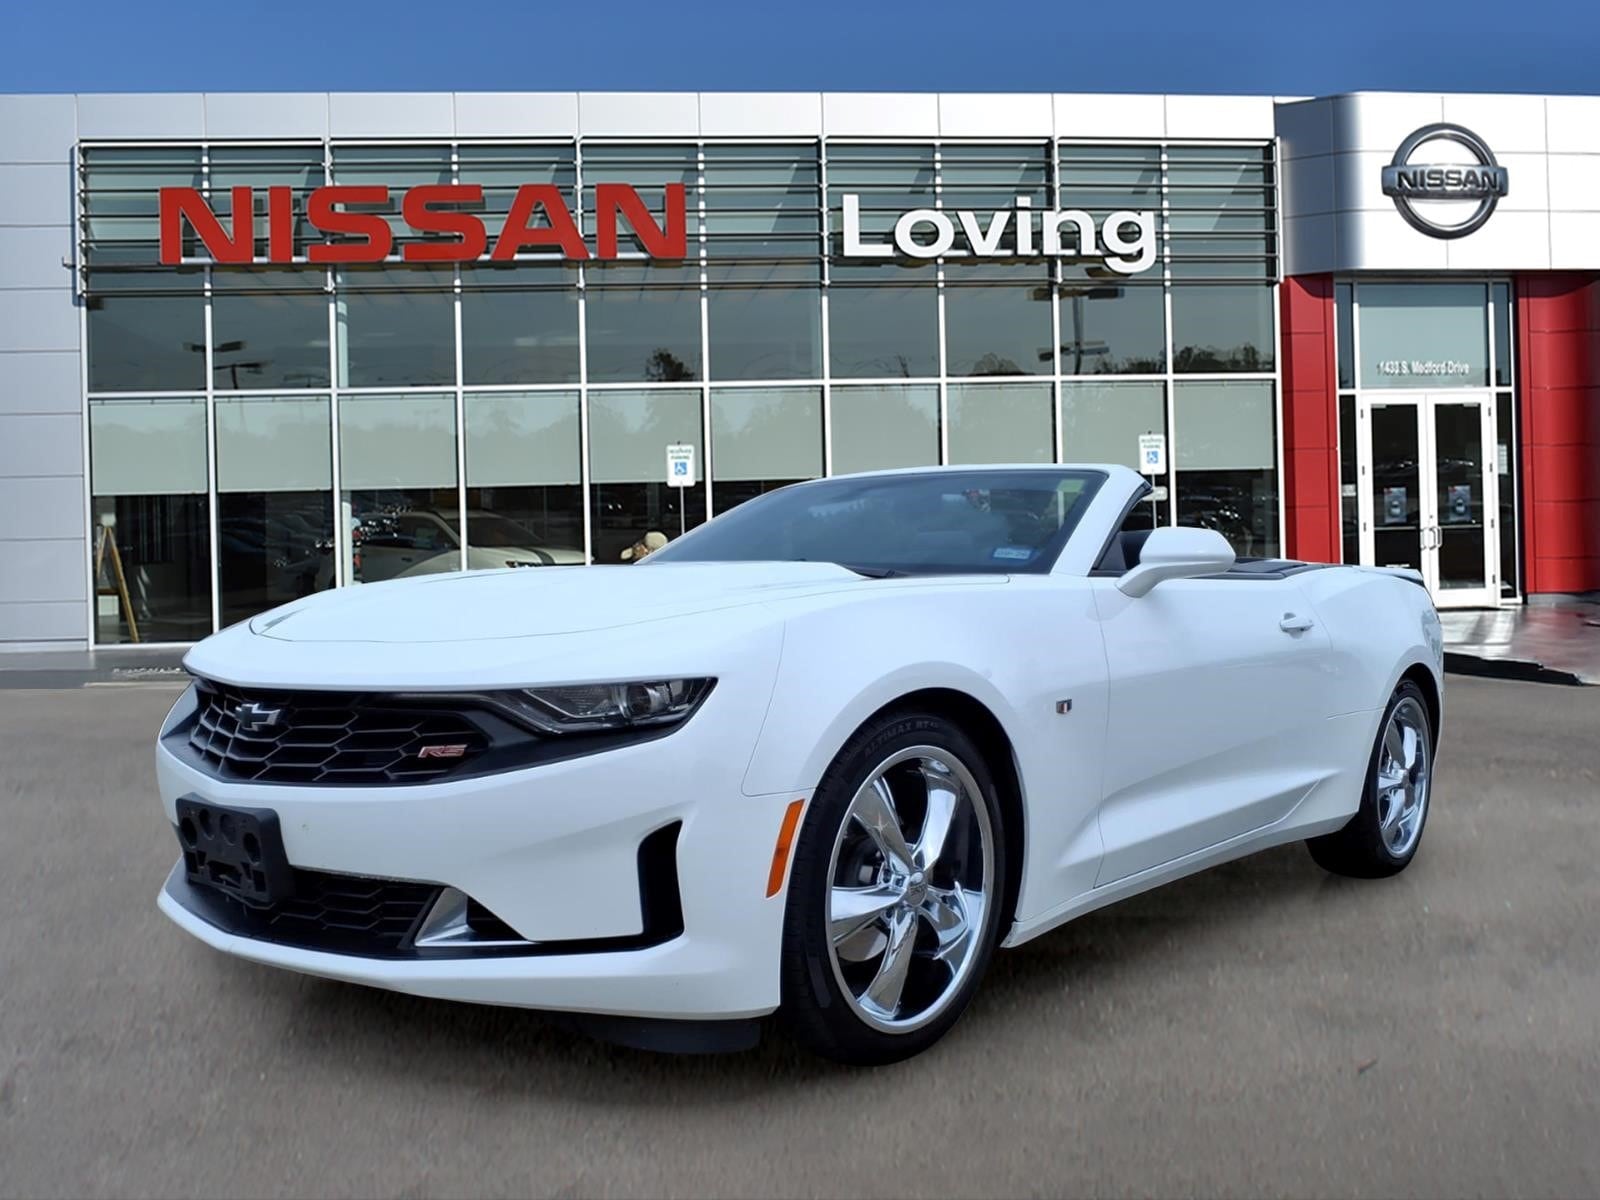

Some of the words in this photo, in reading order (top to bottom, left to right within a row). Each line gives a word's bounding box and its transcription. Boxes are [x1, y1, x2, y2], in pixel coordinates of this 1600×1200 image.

[1396, 169, 1498, 189] NISSAN
[159, 183, 686, 265] NISSAN
[842, 194, 1157, 274] Loving
[1447, 360, 1470, 374] Drive
[417, 744, 468, 758] RS
